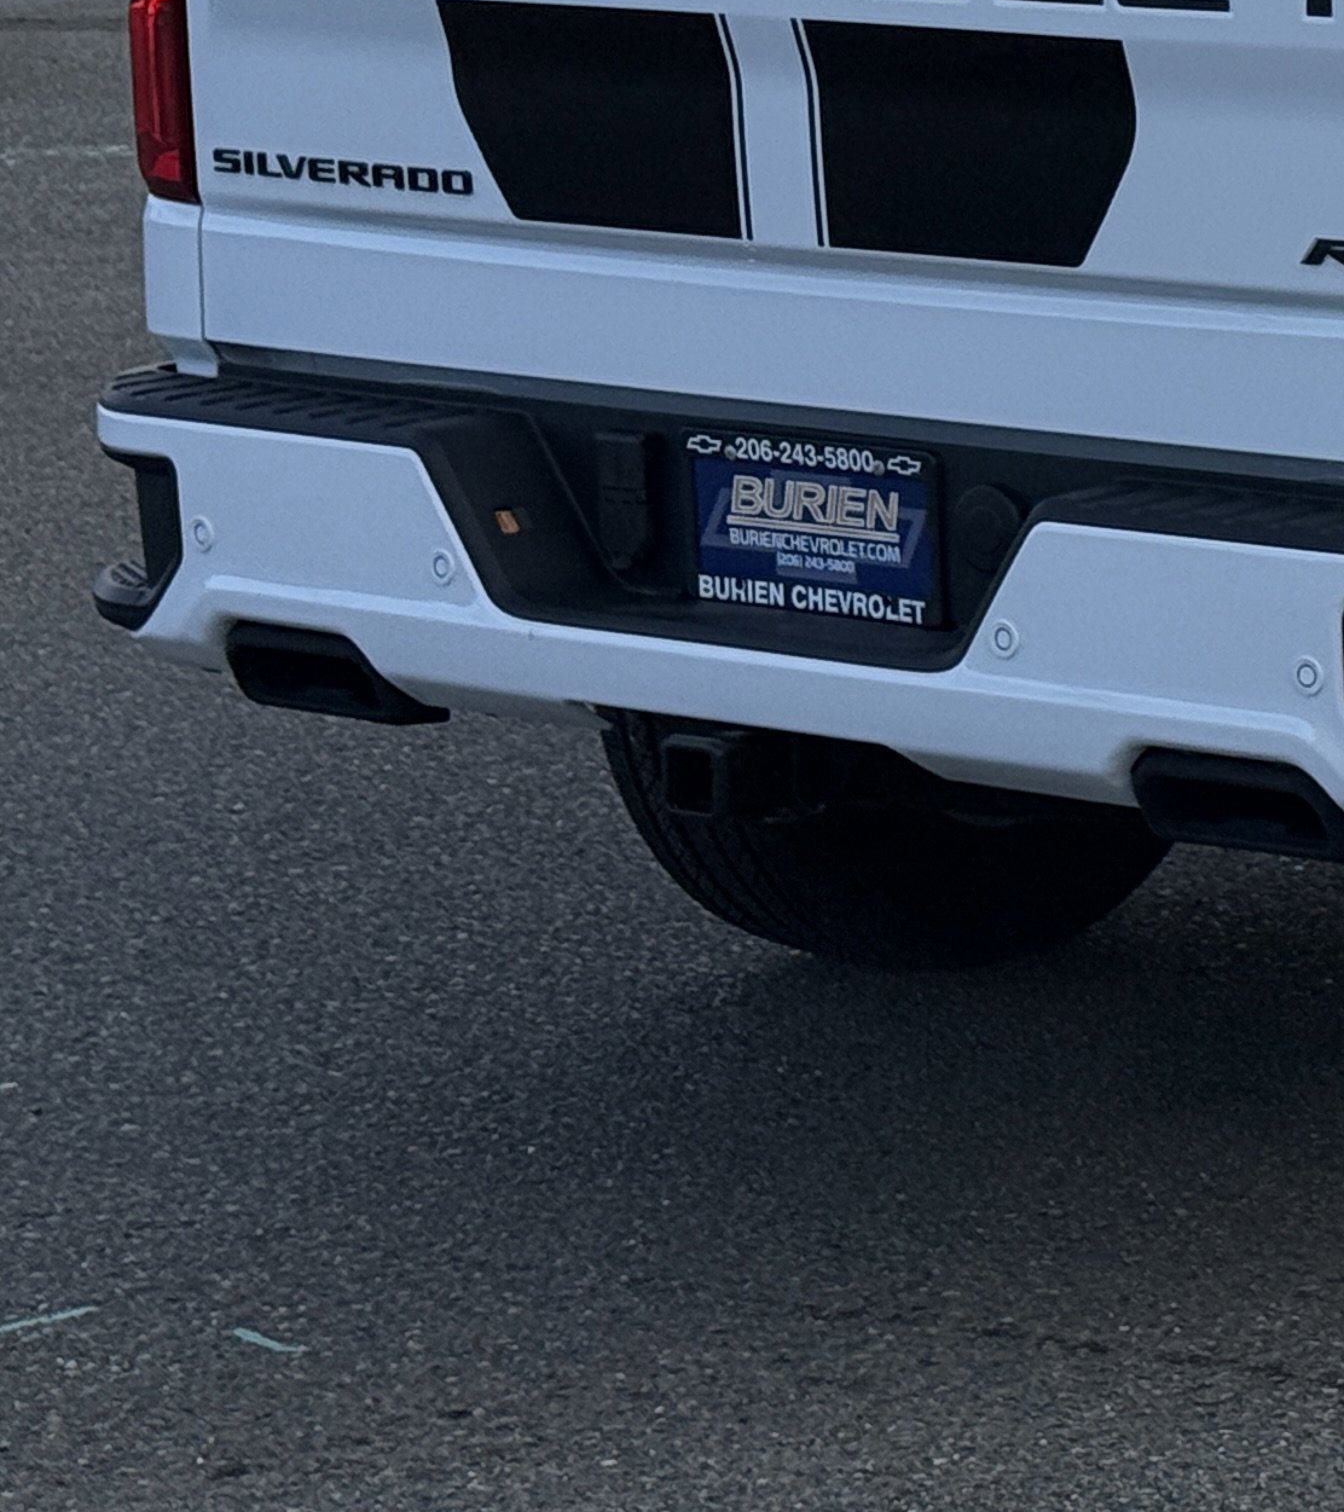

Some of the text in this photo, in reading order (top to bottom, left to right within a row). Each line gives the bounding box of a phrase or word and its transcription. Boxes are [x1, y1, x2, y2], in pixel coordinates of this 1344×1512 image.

[213, 148, 474, 196] SILVERADO
[735, 437, 874, 473] 206-243-5800
[730, 474, 899, 531] BURIEN
[698, 574, 926, 625] BURIEN CHEVROLET
